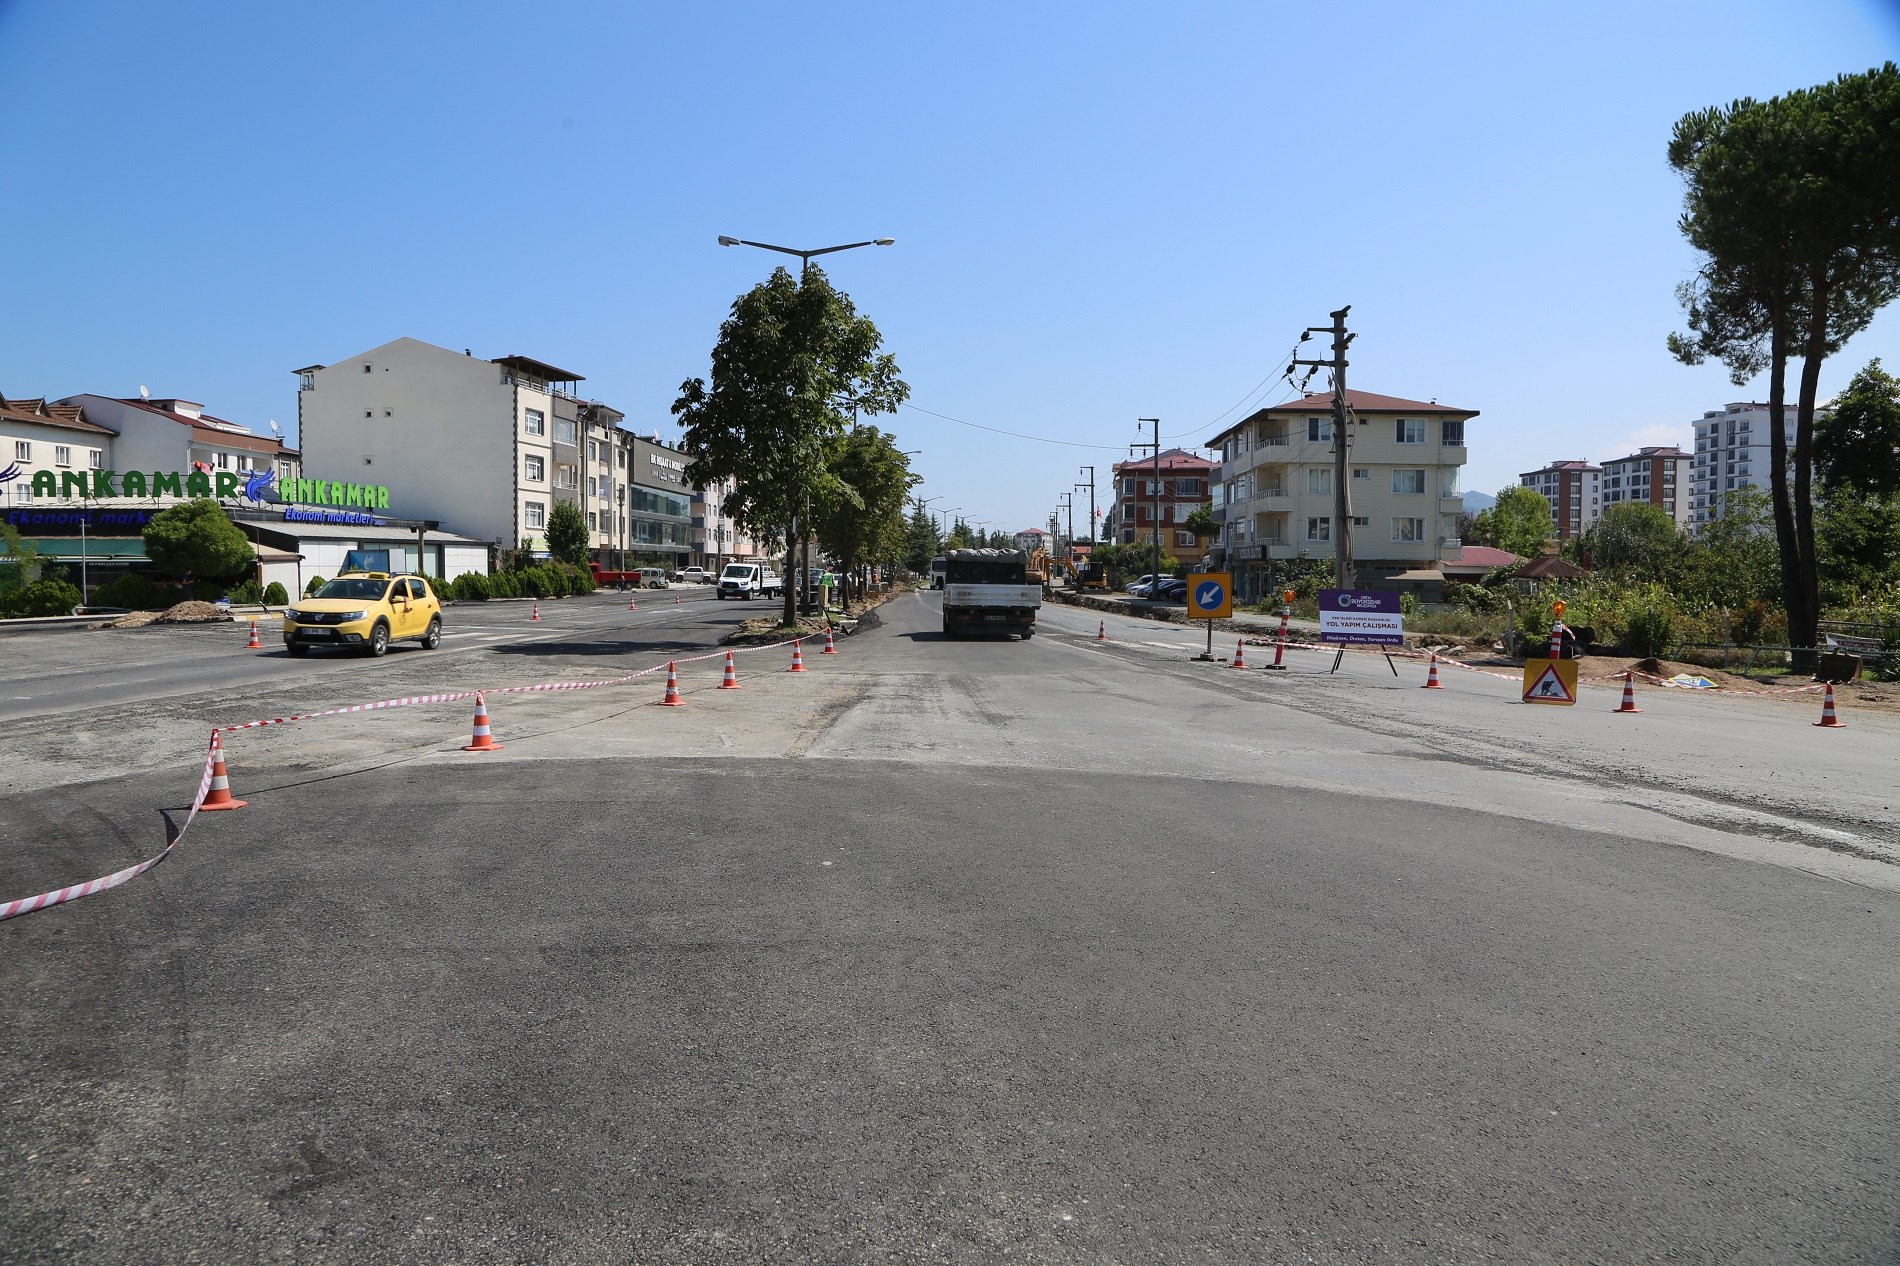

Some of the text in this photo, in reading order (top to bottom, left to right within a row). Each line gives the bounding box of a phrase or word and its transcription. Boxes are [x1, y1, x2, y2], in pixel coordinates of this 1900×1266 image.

[31, 470, 239, 498] ANKAMAR
[279, 476, 390, 509] ANKAMAR
[8, 510, 93, 526] Ekonomi
[284, 508, 326, 523] Ekonomi
[327, 511, 374, 526] marketleri
